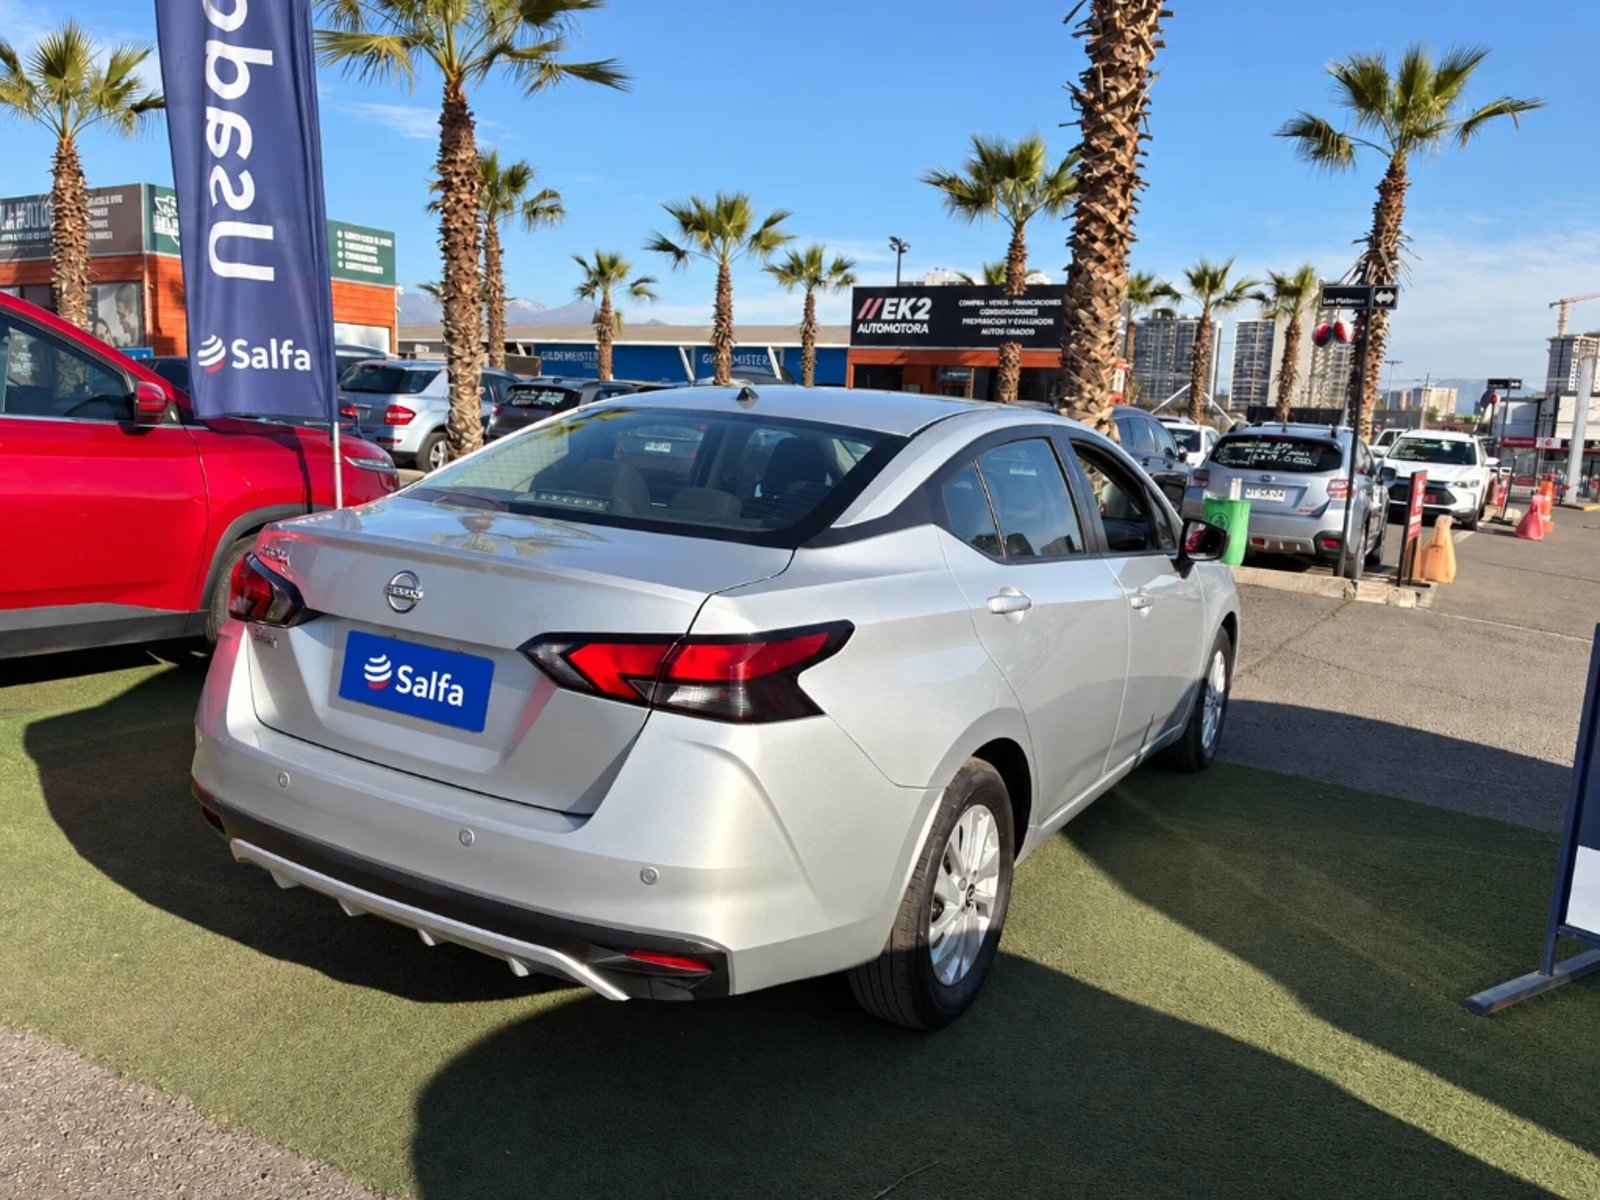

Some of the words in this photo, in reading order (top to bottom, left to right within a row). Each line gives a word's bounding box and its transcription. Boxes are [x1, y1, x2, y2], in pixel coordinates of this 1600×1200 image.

[857, 323, 929, 334] AUTOMOTORA
[231, 338, 312, 371] Salfa
[395, 664, 464, 707] Salfa
